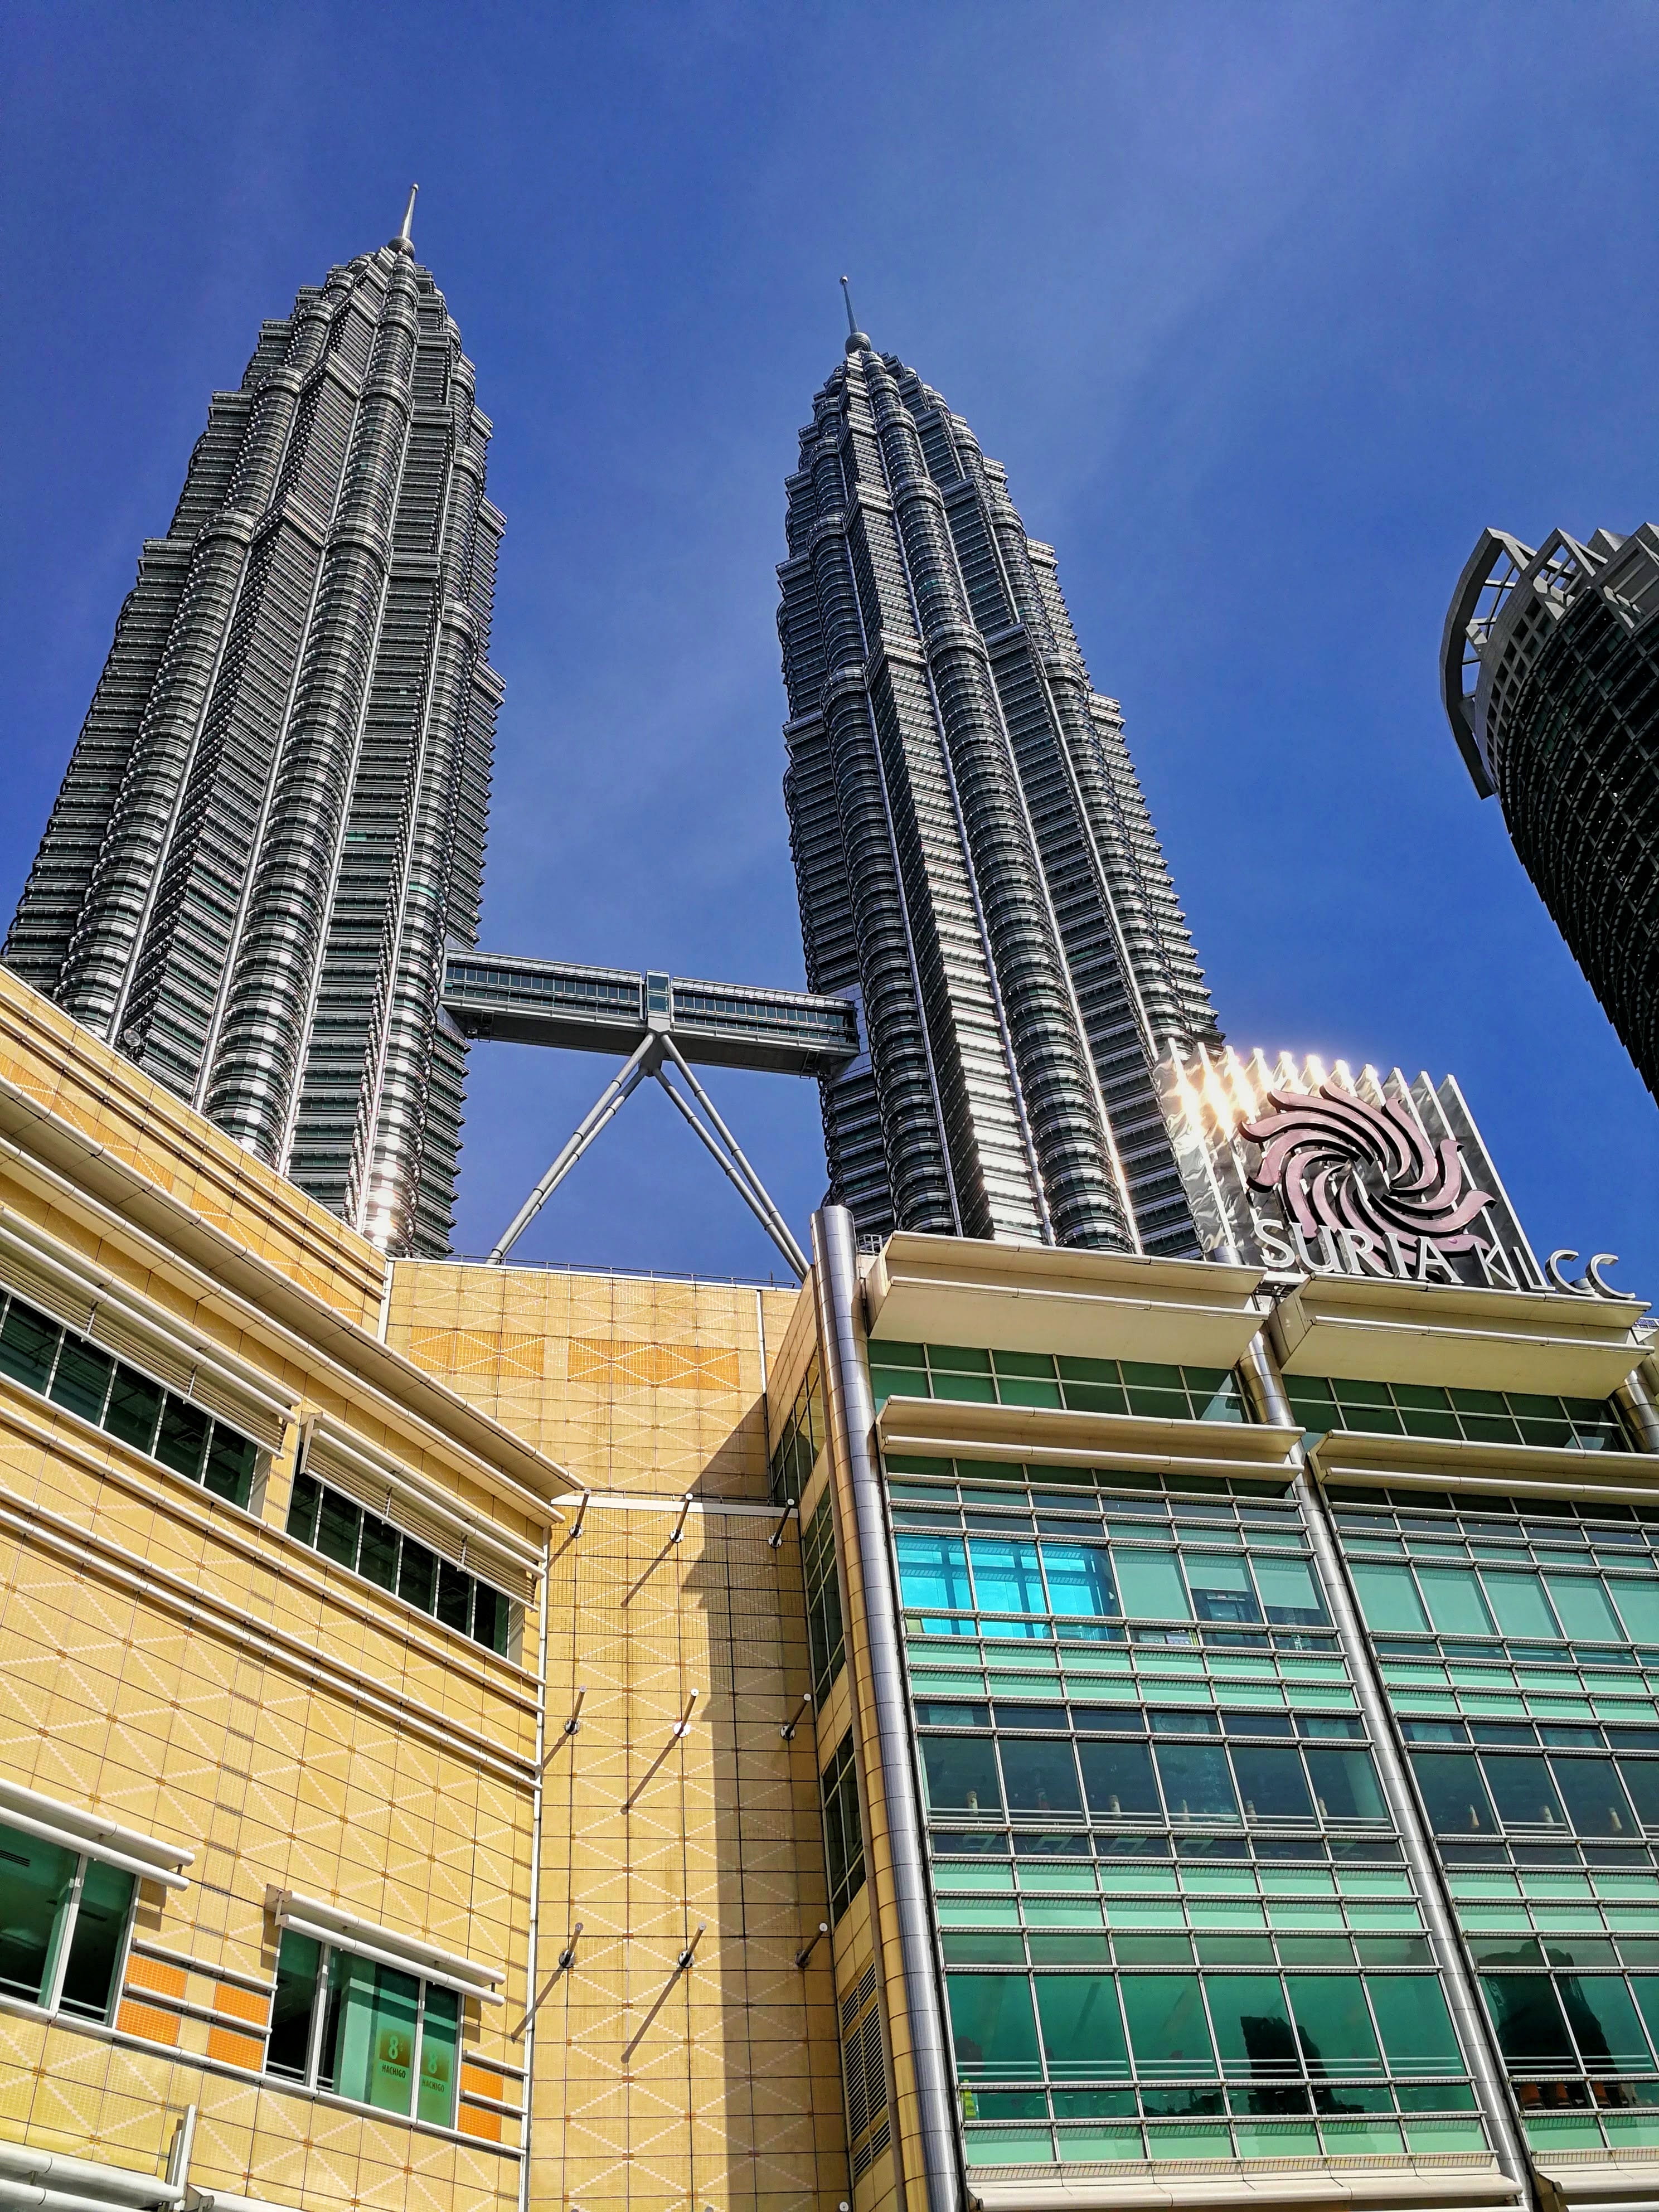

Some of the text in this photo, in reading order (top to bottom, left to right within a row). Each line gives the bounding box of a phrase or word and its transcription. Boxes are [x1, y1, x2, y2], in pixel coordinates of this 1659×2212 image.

[1254, 1219, 1636, 1300] SURIA KLCC
[381, 2064, 406, 2078] HACHIGO
[422, 2079, 445, 2092] HACHIGO
